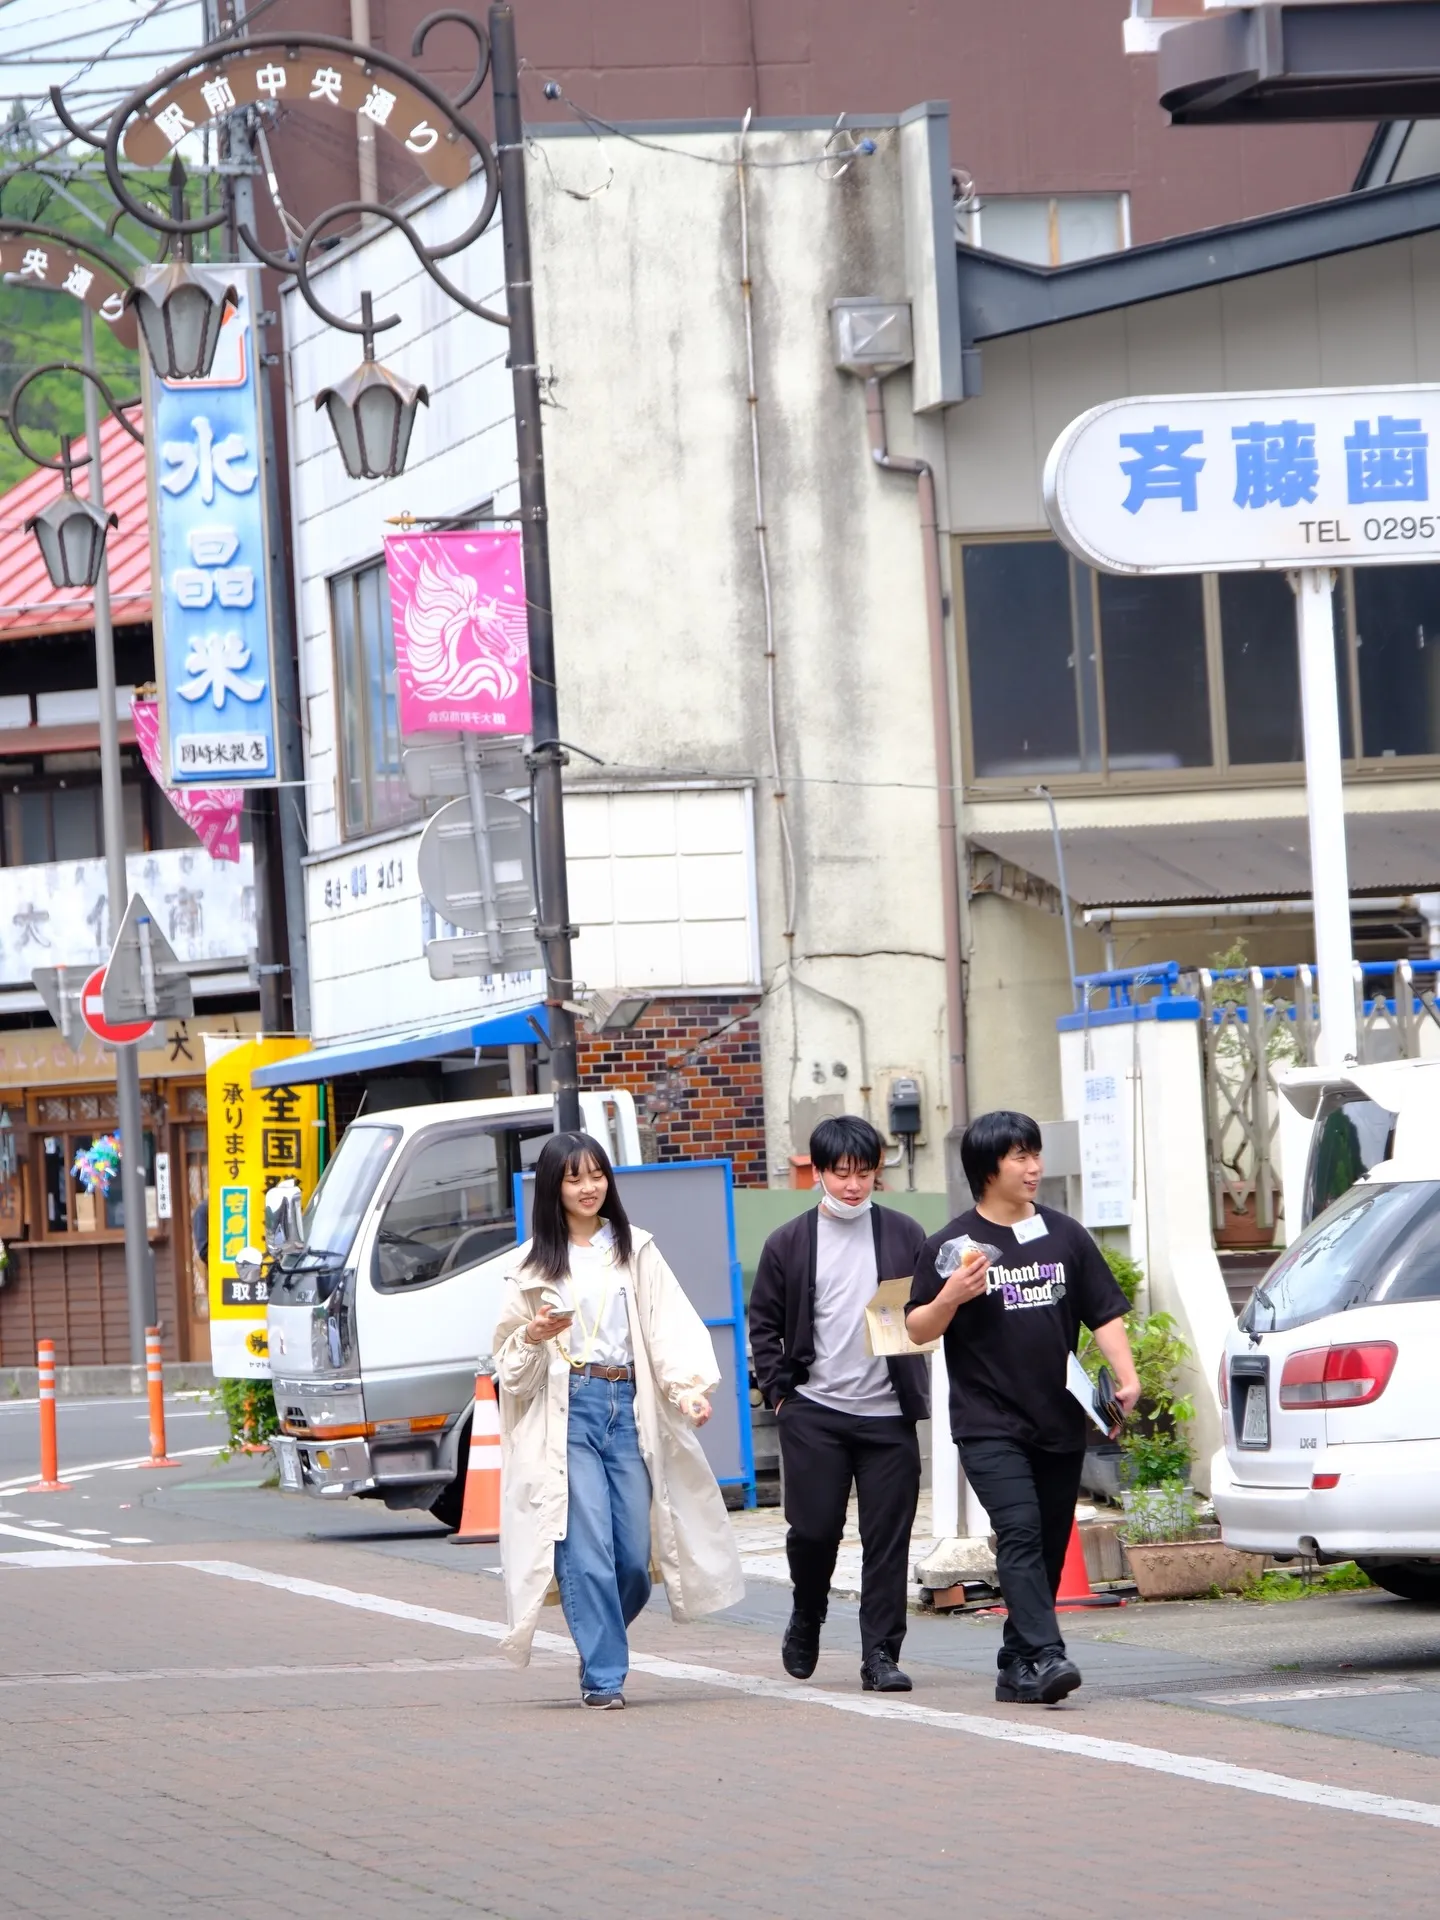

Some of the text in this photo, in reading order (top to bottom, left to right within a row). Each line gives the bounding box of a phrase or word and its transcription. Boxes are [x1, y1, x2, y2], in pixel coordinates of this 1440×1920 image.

[154, 63, 439, 154] 駅前中央通り
[0, 247, 126, 322] 央通り
[1119, 415, 1429, 515] 斉藤歯
[160, 415, 266, 710] 水晶米
[1299, 516, 1440, 544] TEL 0295
[222, 1083, 246, 1180] 承ります
[986, 1261, 1066, 1296] Phantom
[1003, 1279, 1054, 1306] Blood
